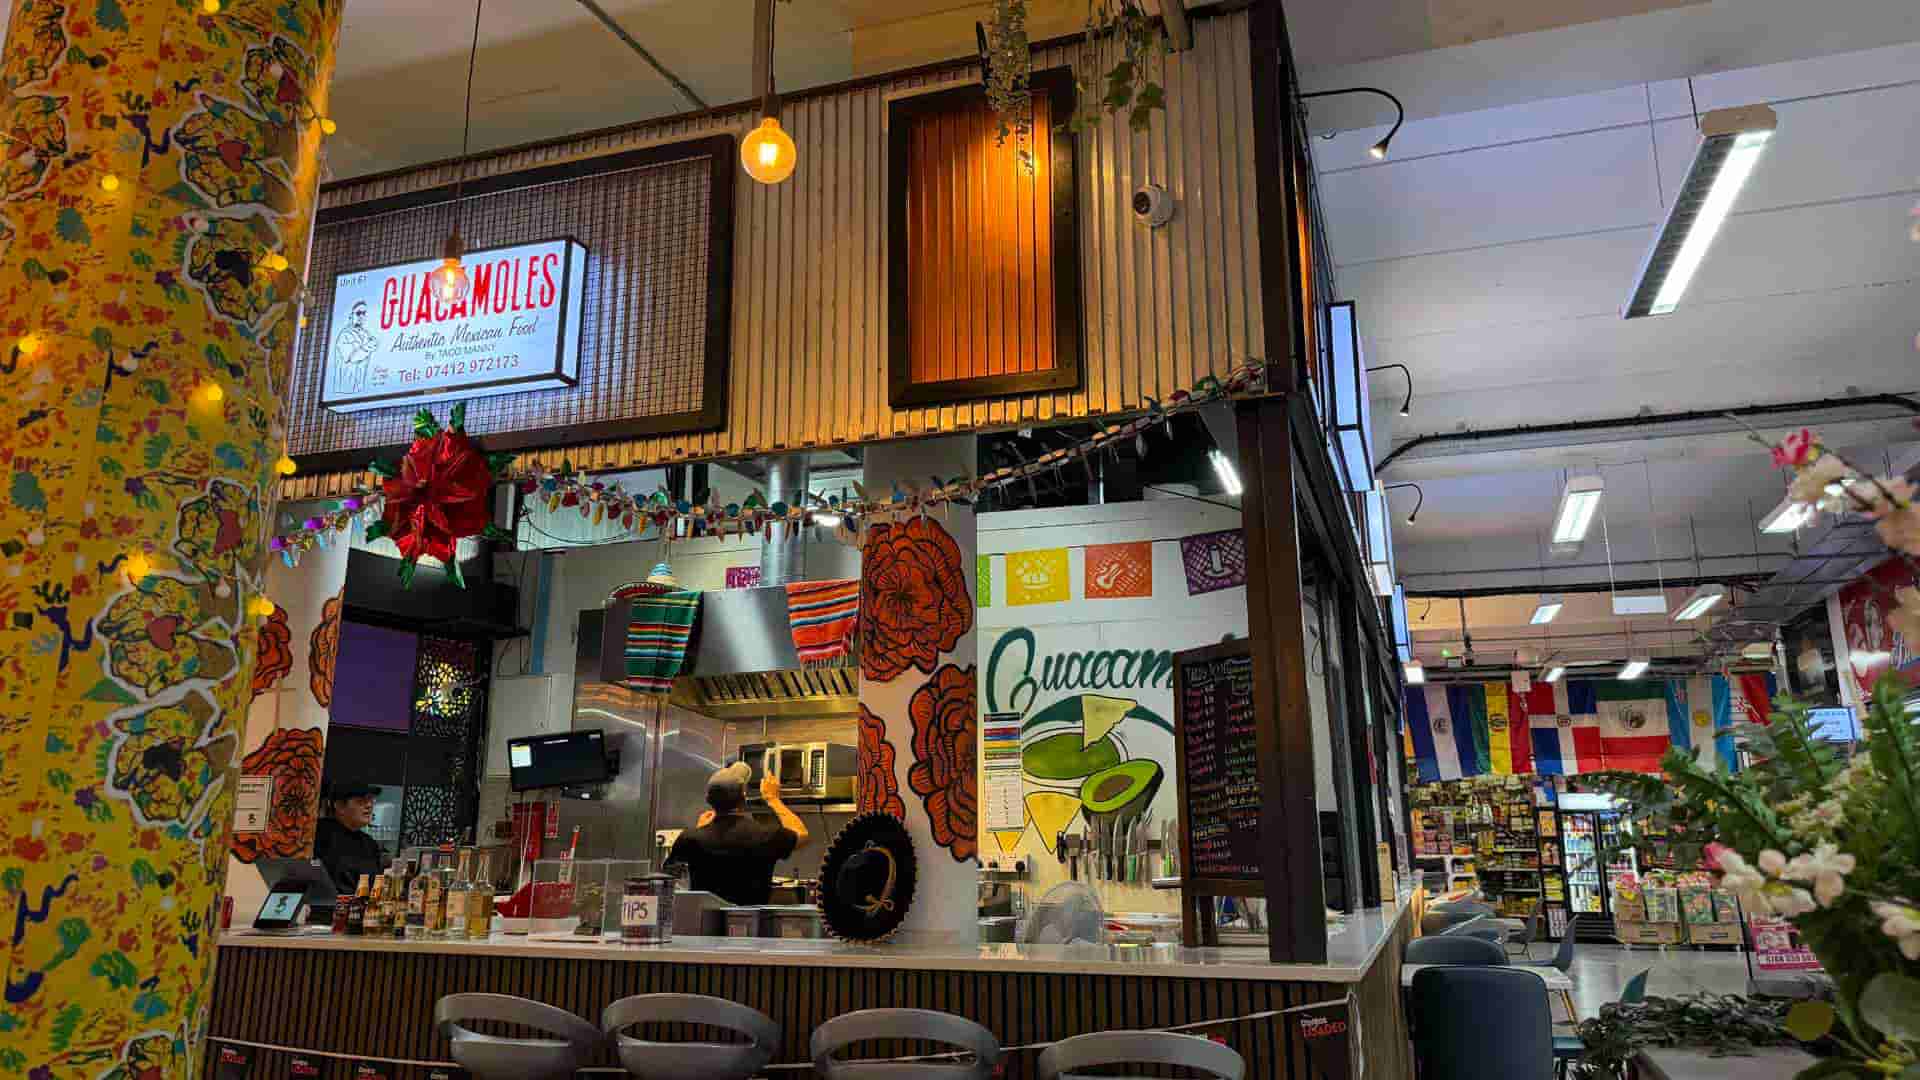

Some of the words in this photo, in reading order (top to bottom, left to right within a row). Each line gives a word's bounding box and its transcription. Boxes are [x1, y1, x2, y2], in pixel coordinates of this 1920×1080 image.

[391, 331, 446, 352] Authentic
[450, 323, 504, 344] Mexican
[508, 316, 537, 337] Food
[399, 368, 421, 383] Tel:
[425, 362, 465, 379] 07412
[469, 354, 520, 374] 972173
[623, 901, 648, 920] TIPS
